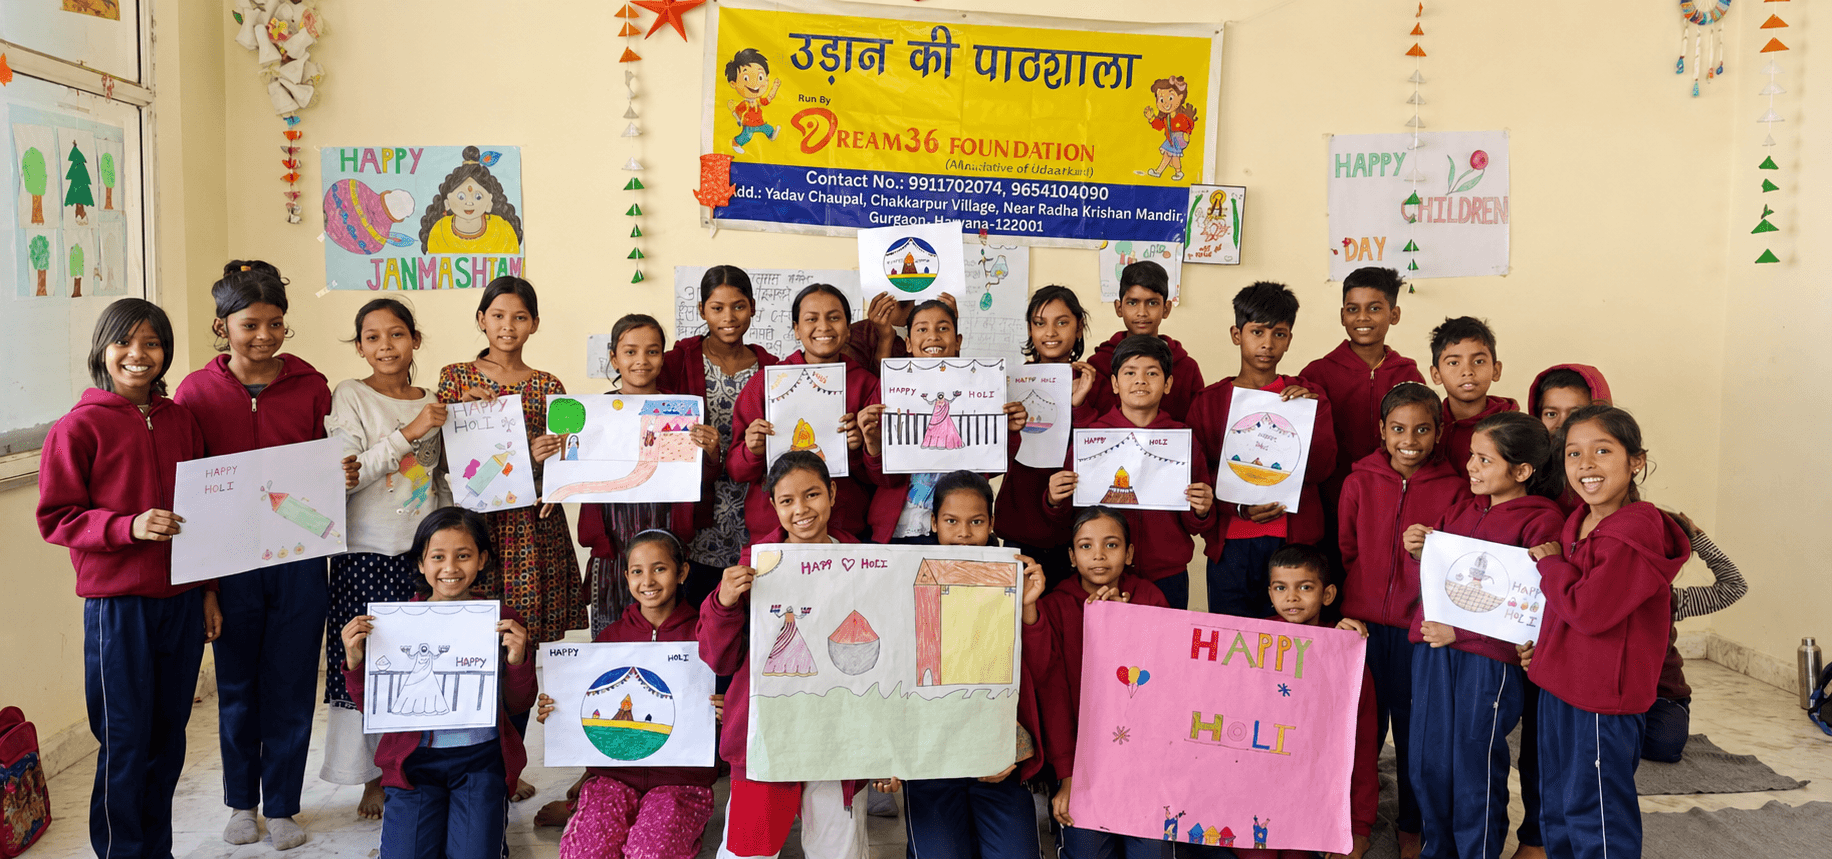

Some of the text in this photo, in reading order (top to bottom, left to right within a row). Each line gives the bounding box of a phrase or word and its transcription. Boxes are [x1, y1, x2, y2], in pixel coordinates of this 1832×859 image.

[789, 25, 1143, 90] उड़ान की पाठशाला
[798, 94, 831, 105] Run By
[950, 138, 1095, 162] FOUNDATION
[340, 148, 424, 174] HAPPY
[1017, 163, 1029, 173] of
[1335, 152, 1406, 178] HAPPY
[806, 170, 1109, 200] Contact No.: 9911702074, 9654104090
[765, 187, 805, 201] Yadav
[808, 190, 867, 207] Chaupal,
[870, 194, 949, 211] Chakkarpur
[951, 199, 999, 215] Village,
[1003, 202, 1035, 215] Near
[1038, 203, 1078, 217] Radha
[1082, 205, 1131, 220] Krishan
[1135, 208, 1184, 223] Mandir,
[1401, 196, 1509, 224] CHILDREN
[1343, 236, 1386, 262] DAY
[889, 387, 995, 399] HAPPY HOLI
[452, 399, 508, 419] HAPPY
[454, 416, 494, 434] HOLI
[205, 465, 238, 479] HAPPY
[204, 481, 235, 495] HOLI
[861, 558, 889, 569] HOLI
[1504, 608, 1538, 628] HOLI
[455, 656, 487, 669] HAPPY
[549, 648, 690, 662] HAPPY HOLI
[1190, 628, 1313, 679] HAPPY
[1190, 711, 1297, 756] HOLI
